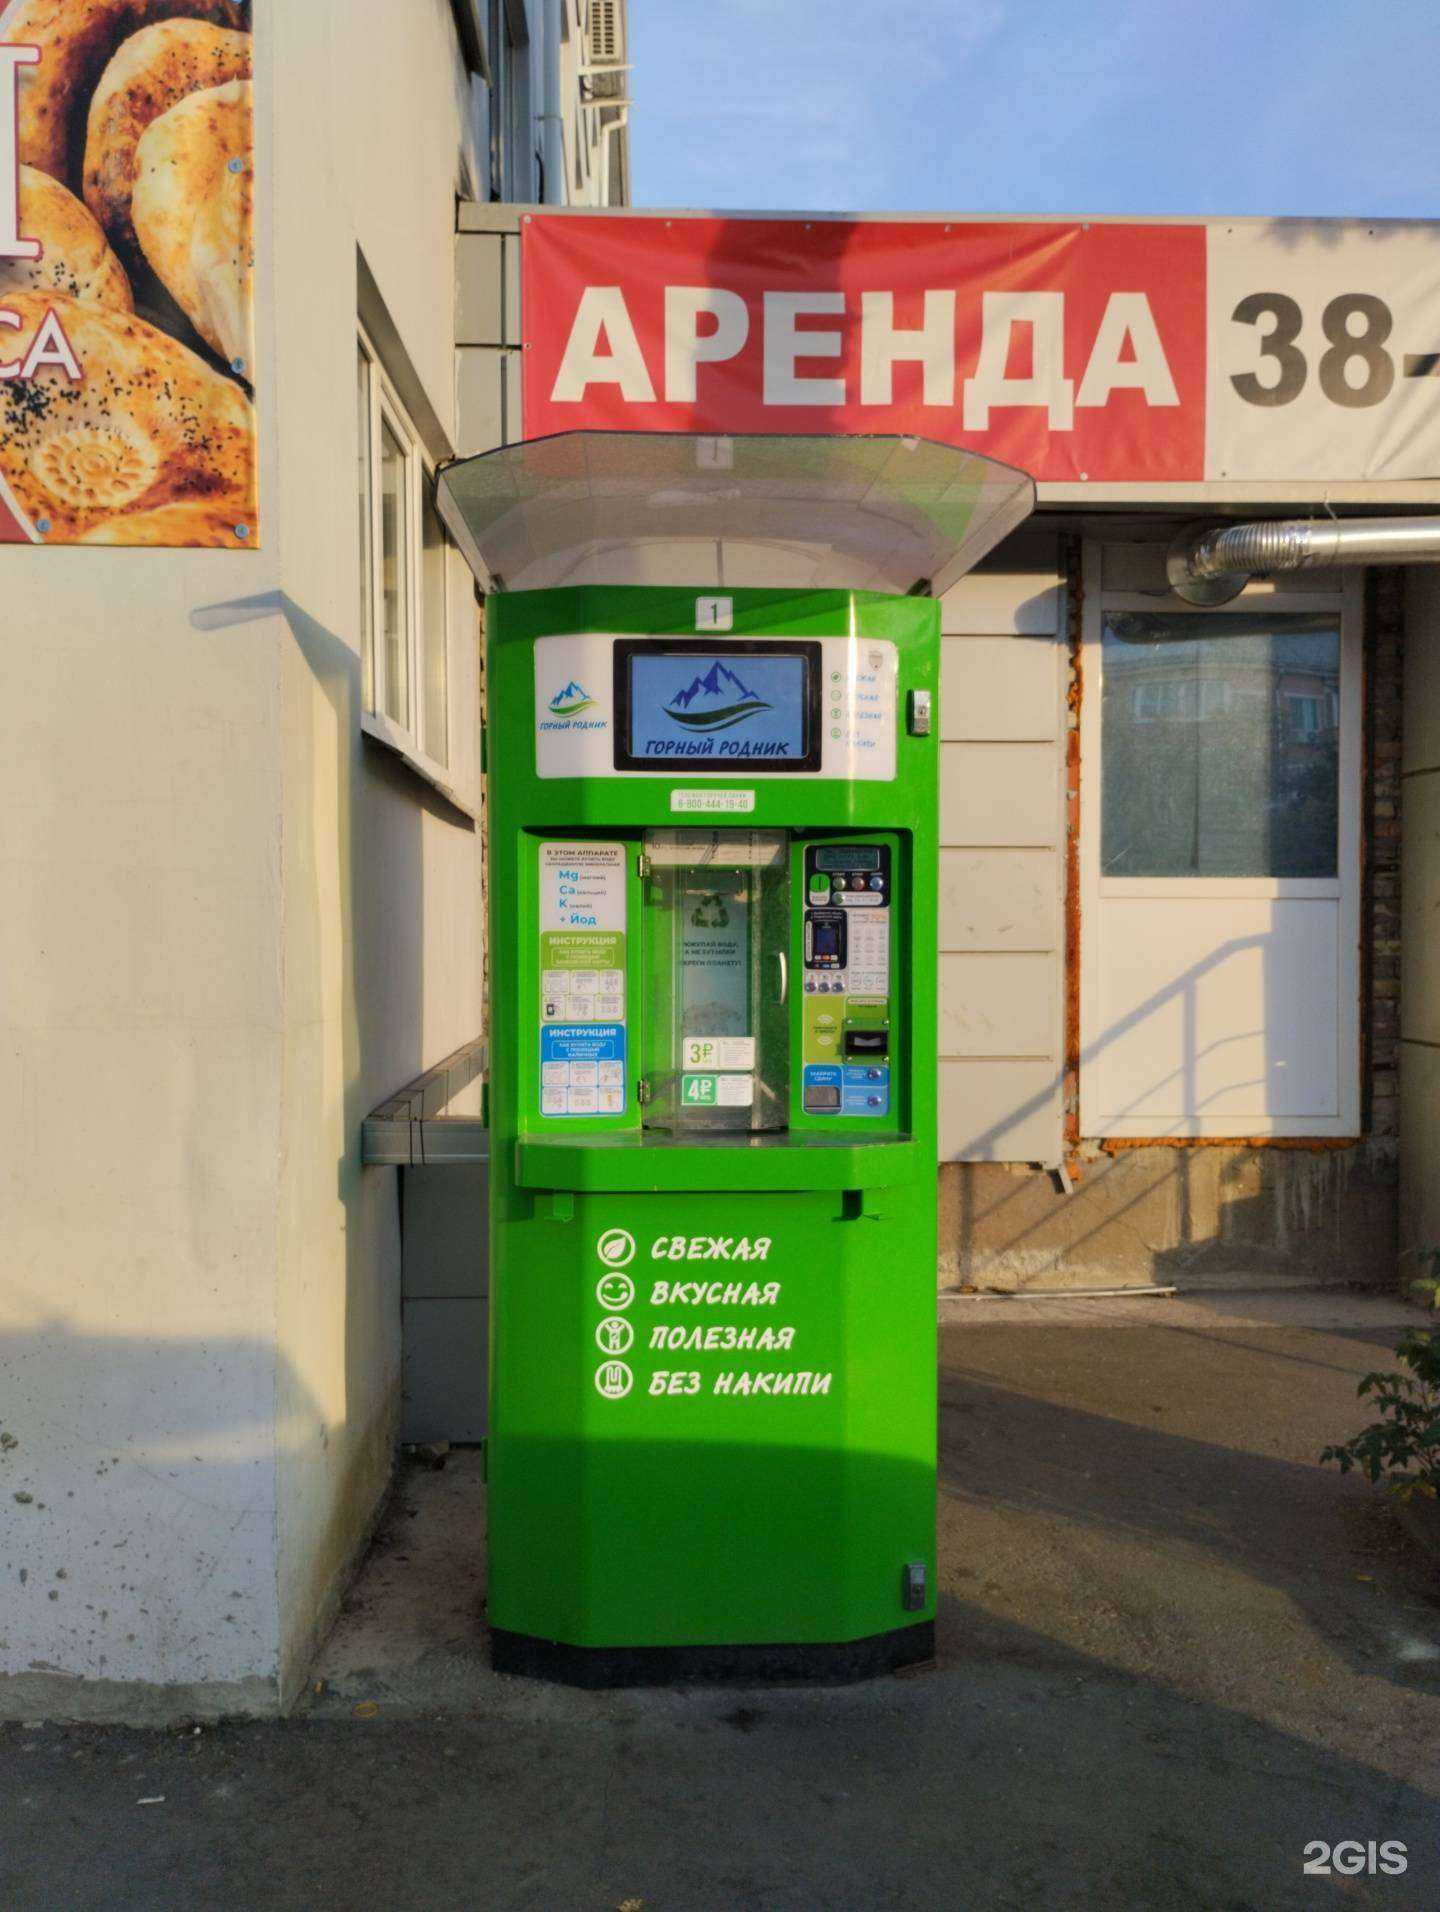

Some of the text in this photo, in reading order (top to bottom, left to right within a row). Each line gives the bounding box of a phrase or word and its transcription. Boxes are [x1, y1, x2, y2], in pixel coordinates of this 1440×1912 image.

[549, 286, 1180, 432] АРЕНДА
[710, 603, 720, 624] 1
[644, 737, 790, 757] ГОРНЫЙ РОДНИК
[559, 870, 579, 881] Mg
[570, 911, 597, 925] Йод
[549, 936, 617, 945] ИНСТРУКЦИЯ
[549, 1028, 617, 1037] ИНСТРУКЦИЯ
[651, 1236, 772, 1261] СВЕЖАЯ
[650, 1280, 781, 1305] ВКУСНАЯ
[648, 1326, 796, 1351] ПОЛЕЗНАЯ
[648, 1371, 832, 1396] БЕЗ НАКИПИ
